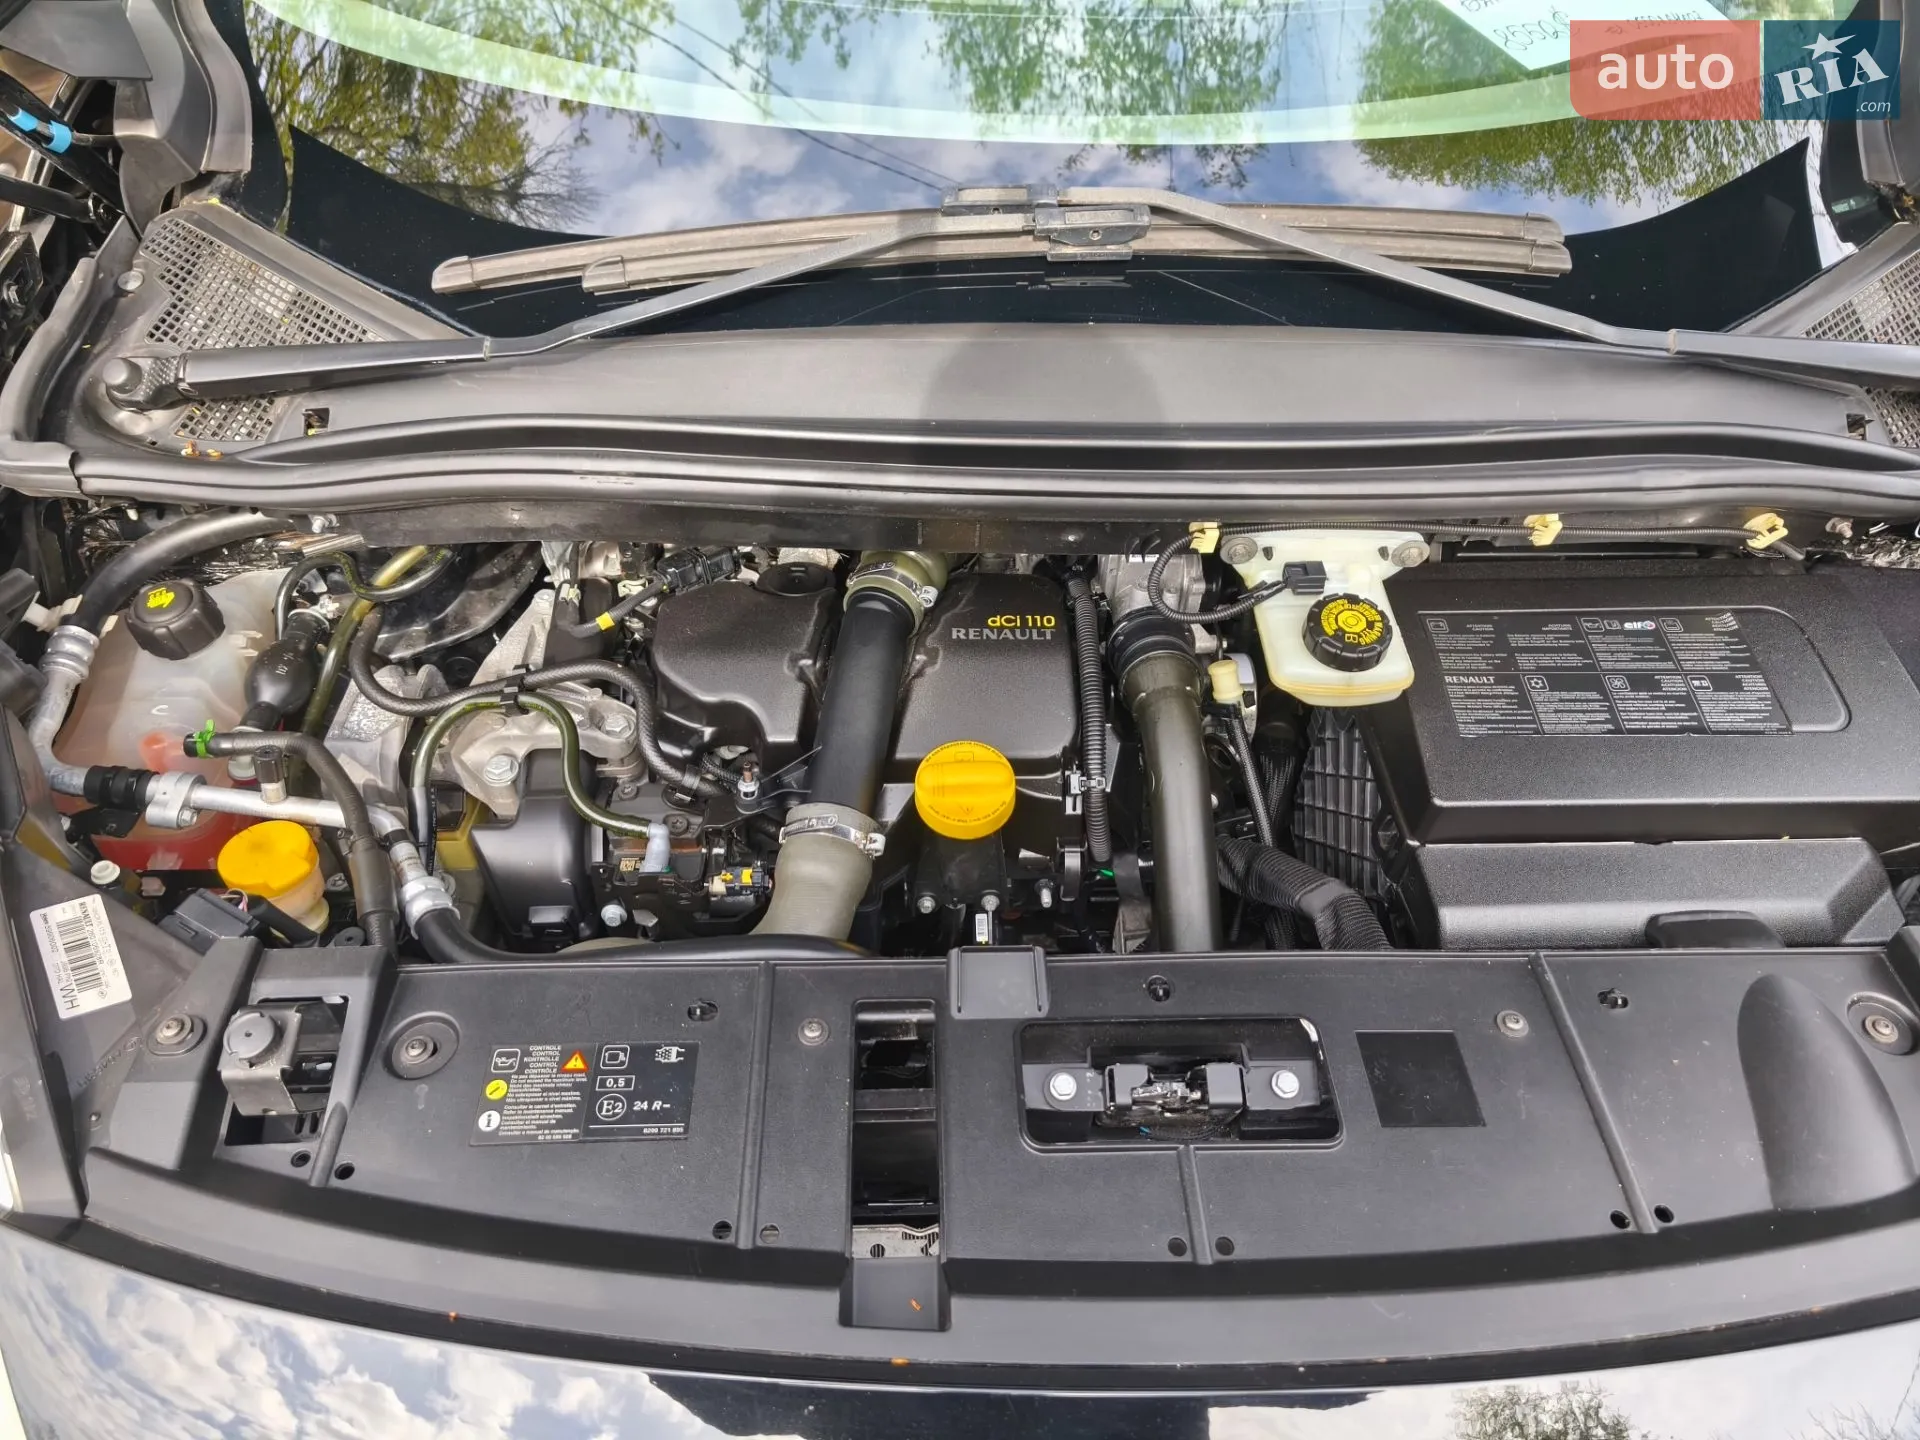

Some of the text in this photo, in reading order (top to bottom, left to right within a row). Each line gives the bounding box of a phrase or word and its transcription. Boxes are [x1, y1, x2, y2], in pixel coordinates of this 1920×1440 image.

[1026, 615, 1056, 627] 110
[951, 628, 1056, 640] RENAULT
[1444, 676, 1495, 684] RENAULT
[606, 1078, 626, 1088] 0,5
[600, 1100, 623, 1116] E2
[633, 1100, 648, 1110] 24
